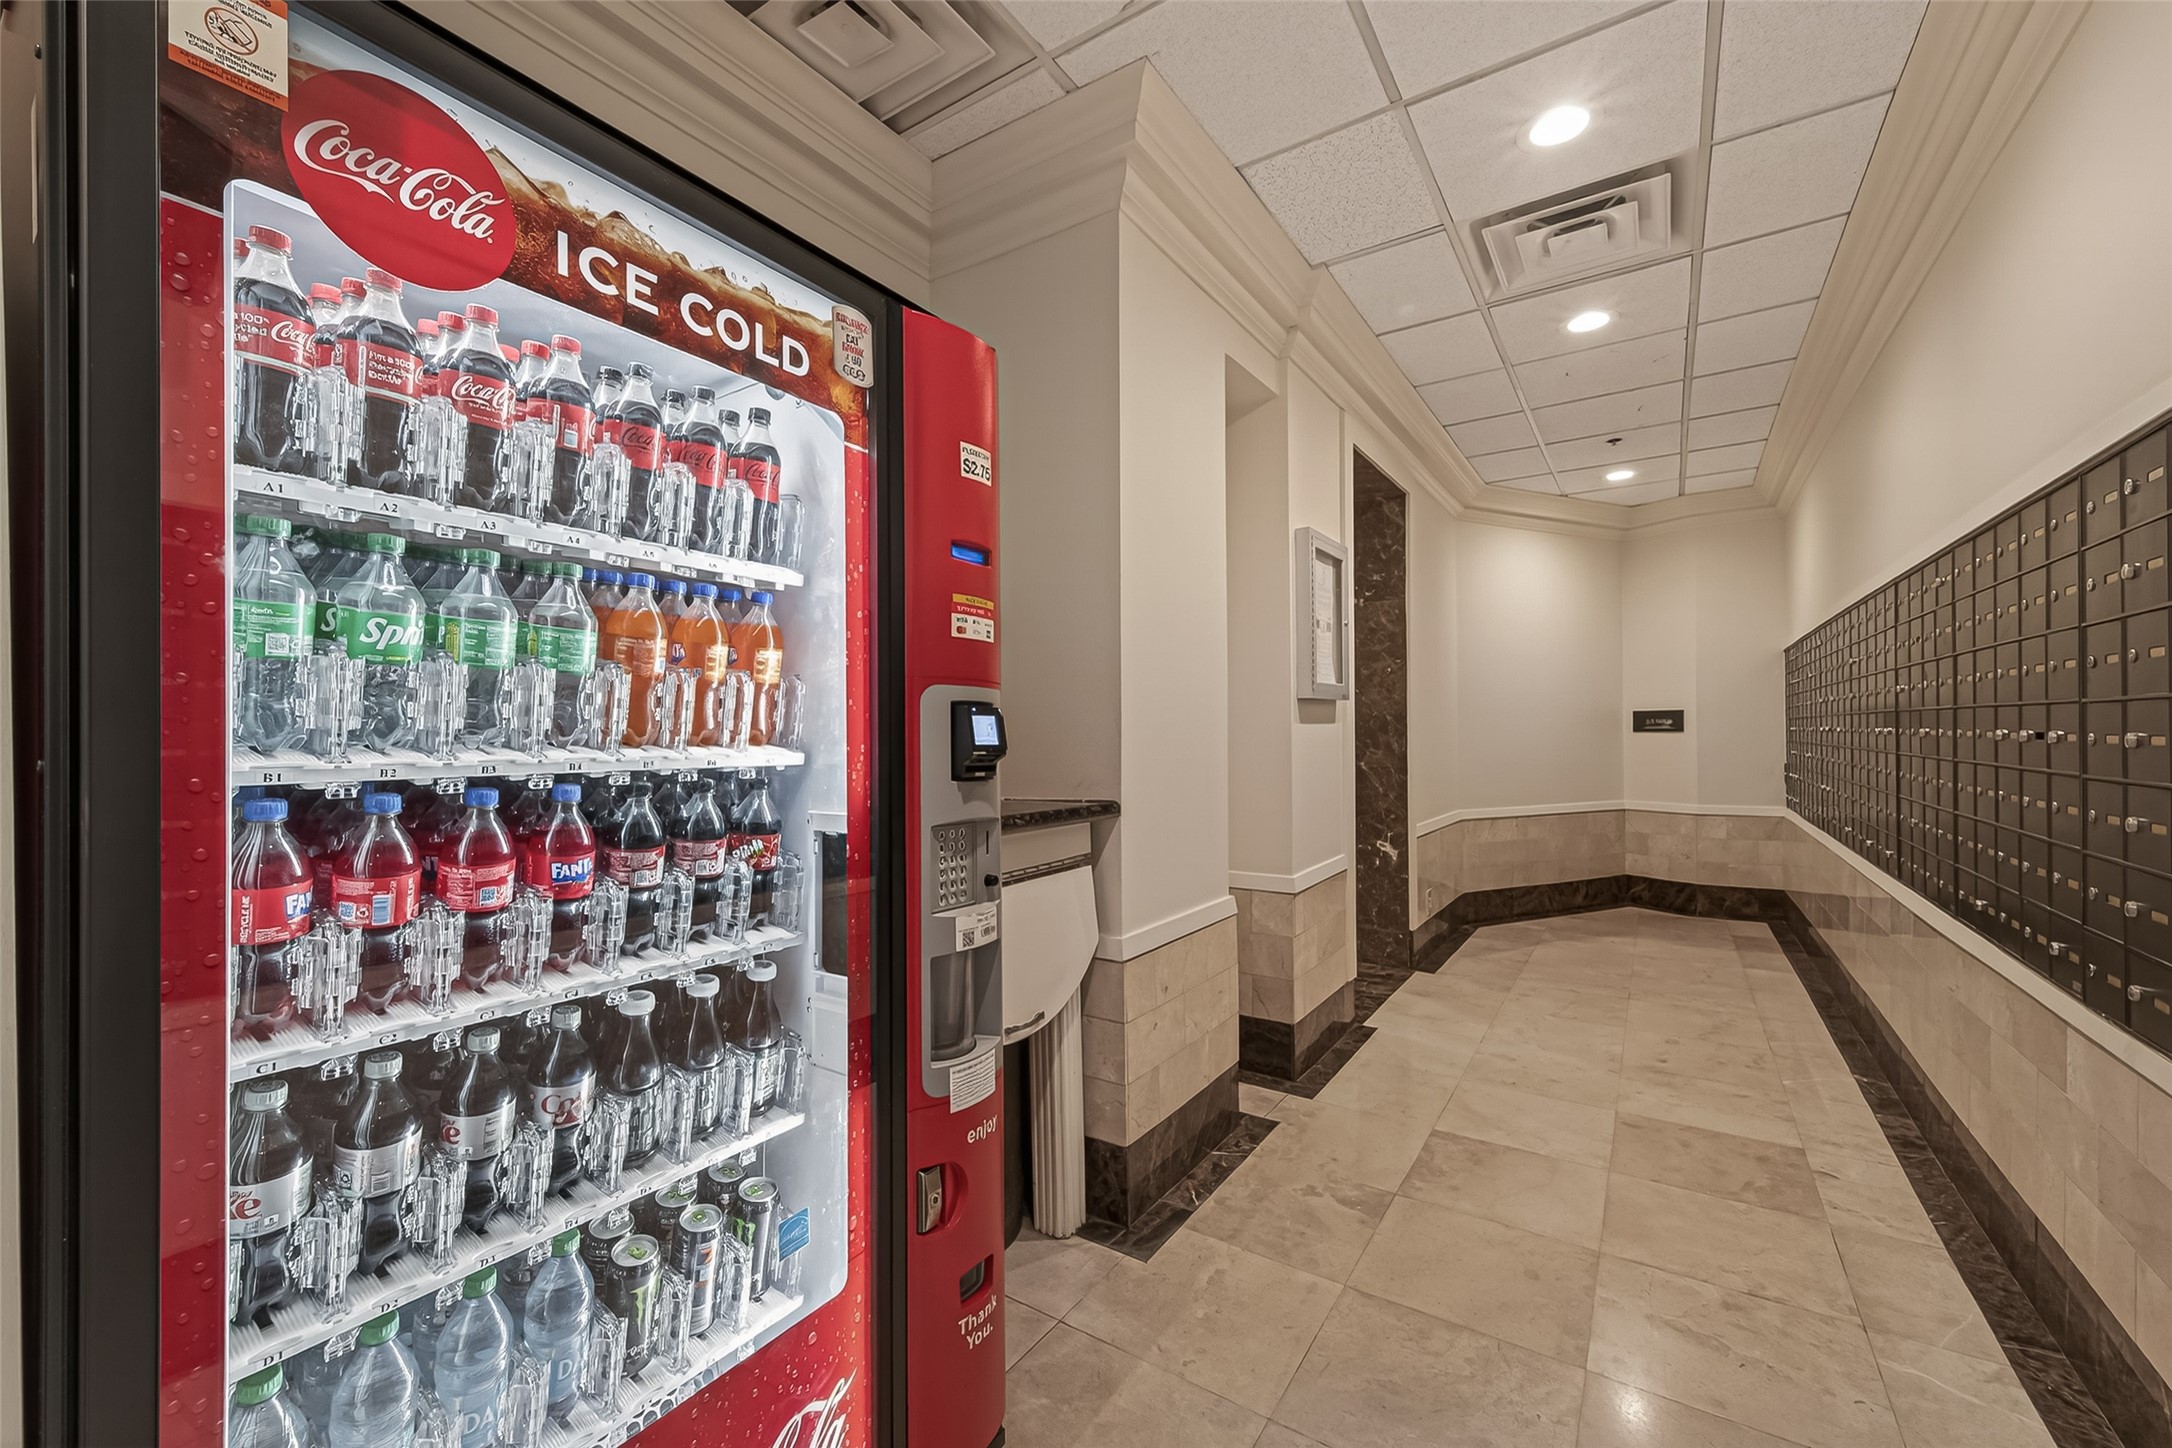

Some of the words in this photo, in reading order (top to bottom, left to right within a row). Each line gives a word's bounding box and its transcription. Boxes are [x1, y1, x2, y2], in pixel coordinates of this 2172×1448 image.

[293, 118, 506, 241] Coca-Cola
[556, 230, 660, 317] ICE
[680, 292, 810, 377] COLD
[263, 482, 284, 494] A1
[380, 502, 398, 513] A2
[480, 520, 497, 530] A3
[263, 772, 282, 783] B1
[256, 1061, 278, 1075] C1
[967, 1114, 998, 1144] enjoy
[958, 1294, 997, 1335] Thank
[966, 1322, 994, 1350] You.
